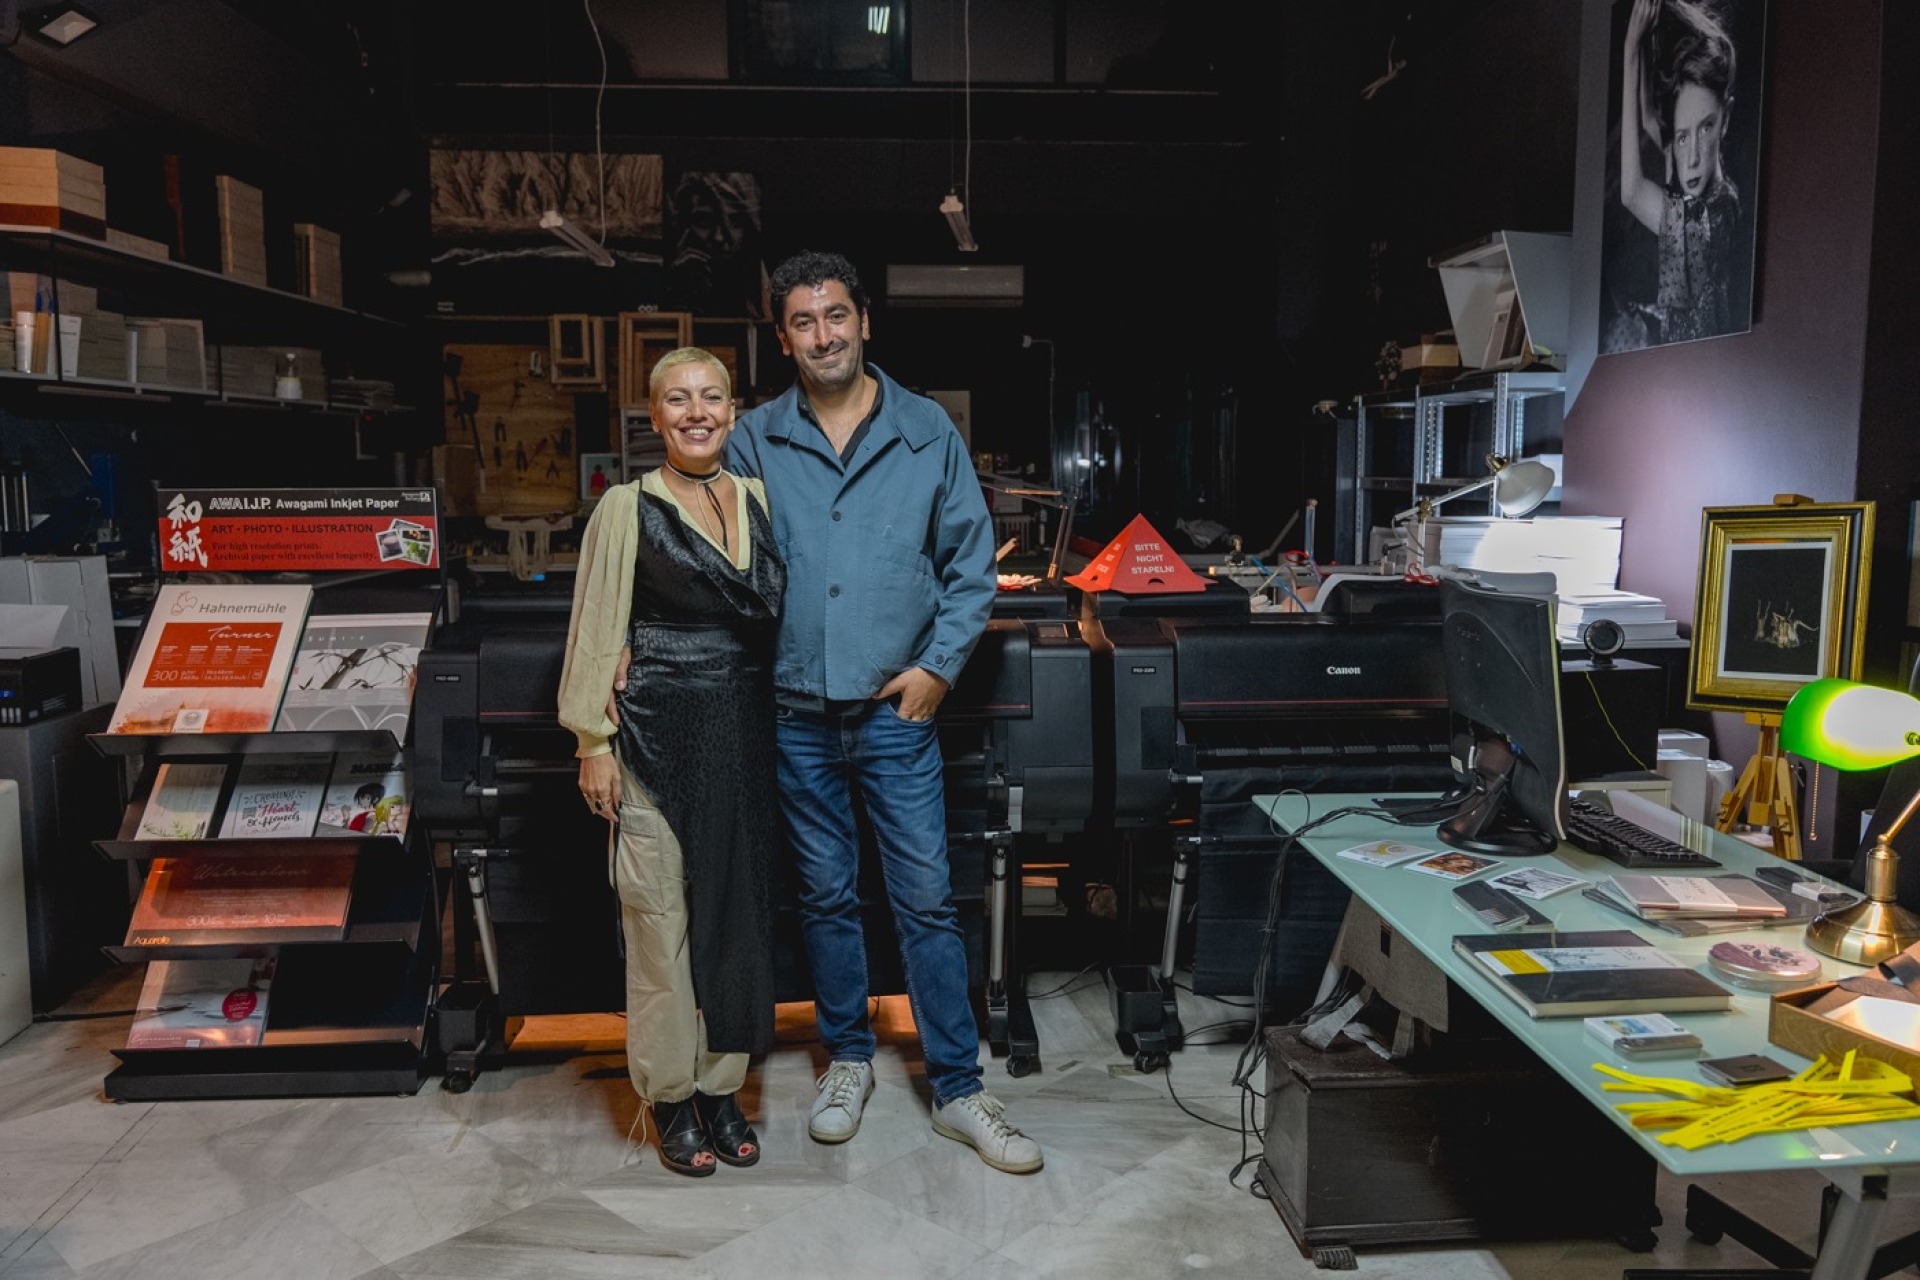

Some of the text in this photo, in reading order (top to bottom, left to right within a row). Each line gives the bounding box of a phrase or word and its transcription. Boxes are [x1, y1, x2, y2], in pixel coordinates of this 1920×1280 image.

[276, 498, 328, 511] Awagami
[331, 498, 363, 511] Inkjet
[366, 498, 400, 510] Paper
[211, 523, 374, 534] ART PHOTO ILLUSTRATION
[212, 542, 226, 551] For
[230, 542, 249, 552] high
[251, 542, 292, 551] resolution
[1135, 543, 1161, 551] BITTE
[213, 552, 250, 561] Archival
[278, 552, 297, 561] with
[1136, 554, 1164, 562] NICHT
[1131, 566, 1175, 574] STAPELN!
[198, 602, 288, 614] Hahnemühle
[1326, 666, 1361, 675] Canon
[151, 670, 178, 681] 300
